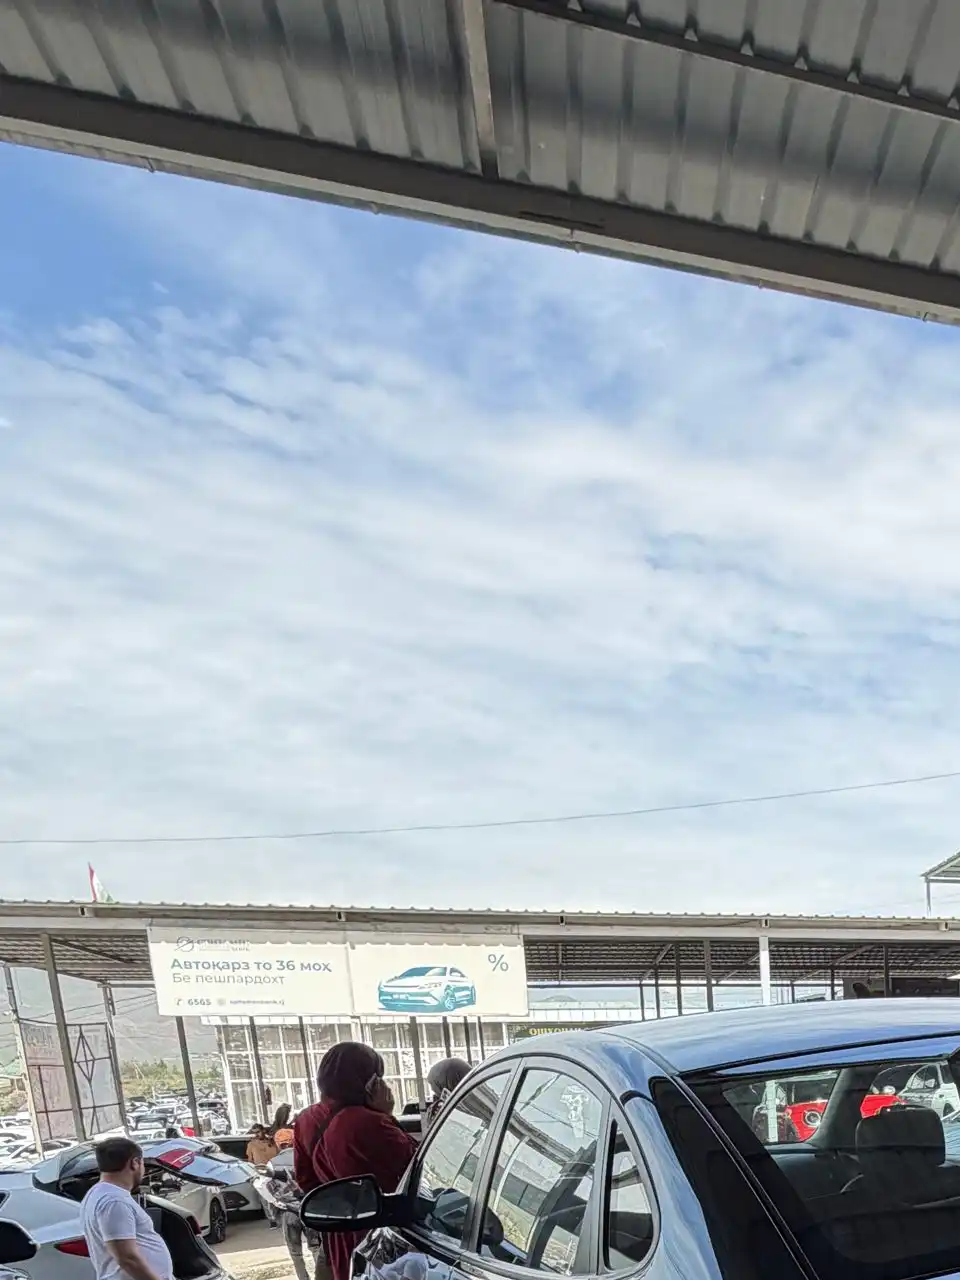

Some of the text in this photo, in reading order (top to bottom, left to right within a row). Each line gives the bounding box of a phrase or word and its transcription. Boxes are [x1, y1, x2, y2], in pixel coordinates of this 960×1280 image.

[170, 958, 250, 972] Автоқарз
[253, 961, 273, 971] то
[275, 960, 296, 971] 36
[487, 953, 509, 972] %
[172, 973, 285, 986] Бе пешпардохт
